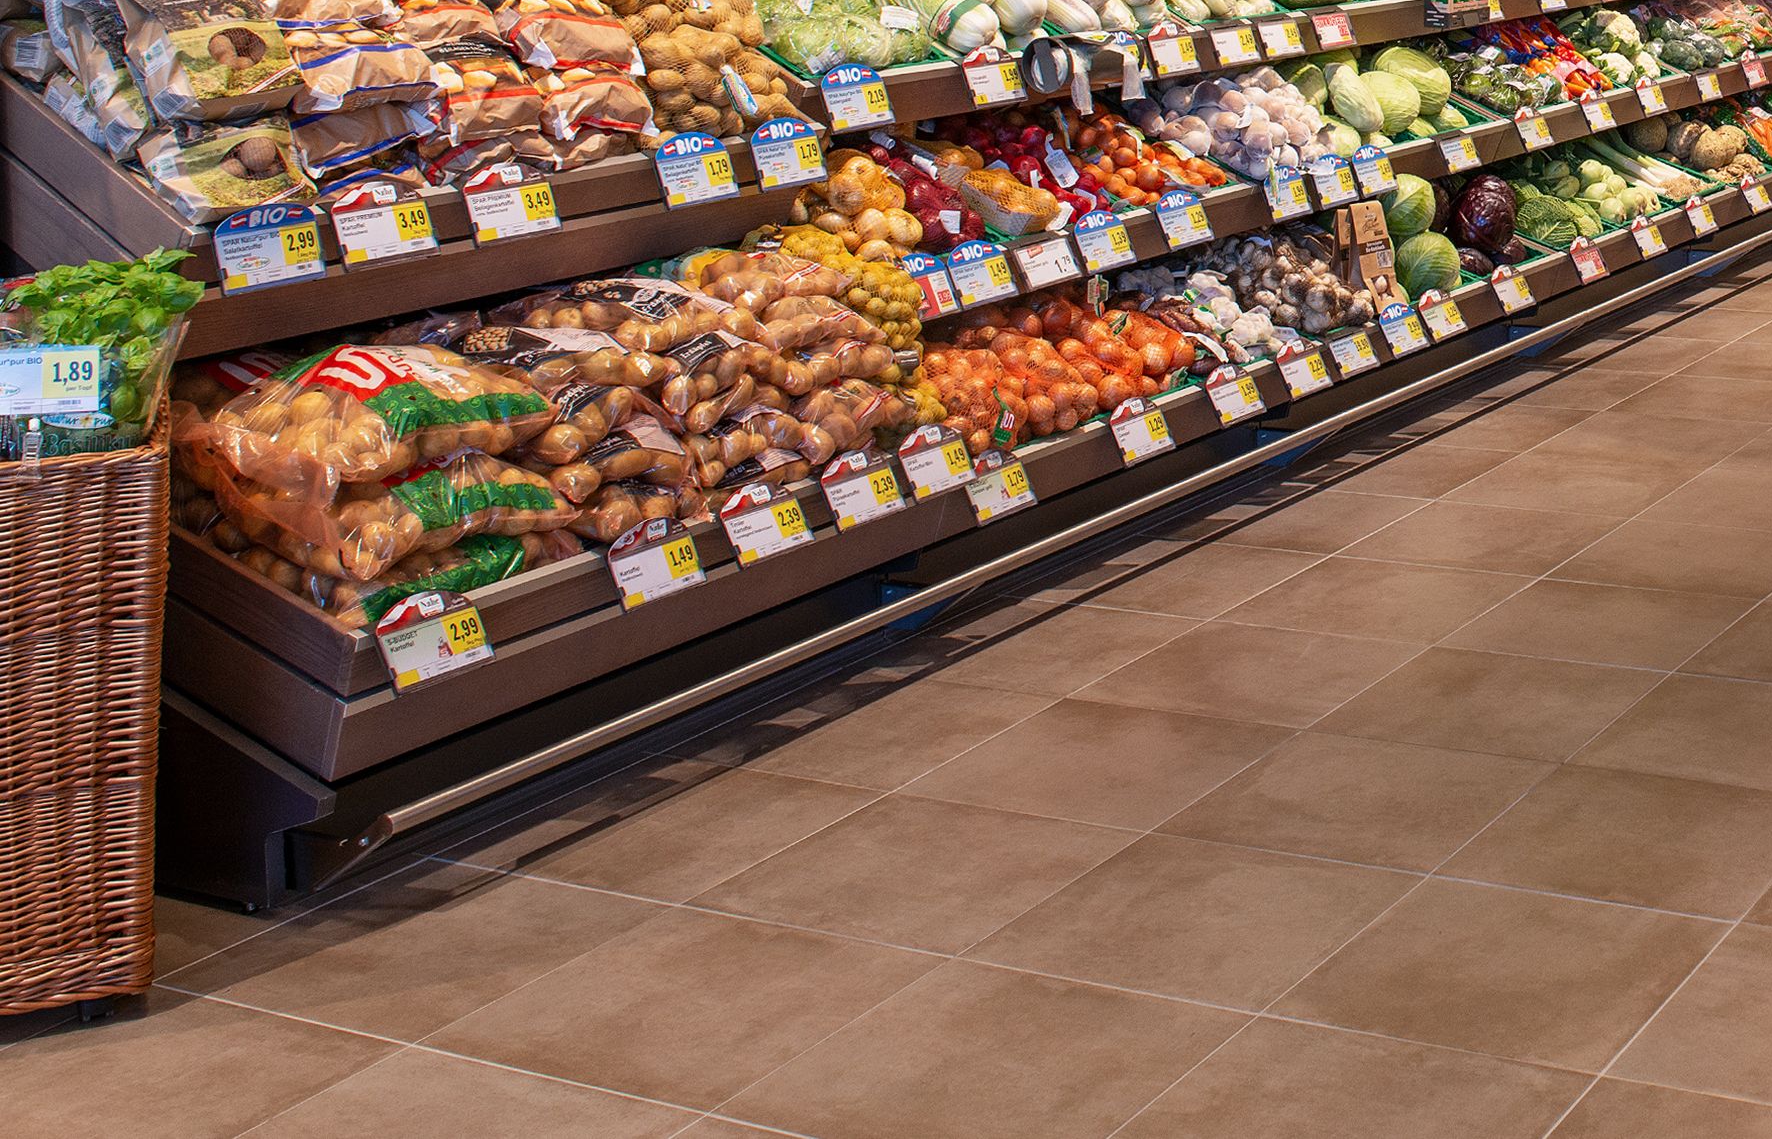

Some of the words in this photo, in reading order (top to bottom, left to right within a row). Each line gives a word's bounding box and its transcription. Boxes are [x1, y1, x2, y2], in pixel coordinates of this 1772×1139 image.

[837, 67, 861, 83] BIO
[868, 89, 885, 105] 2,19
[769, 122, 794, 139] BIO
[675, 137, 701, 155] BIO
[800, 143, 817, 160] 1,79
[1361, 149, 1374, 159] BIO
[709, 159, 728, 176] 1,79
[526, 190, 550, 211] 3,49
[1167, 194, 1184, 208] BIO
[249, 207, 286, 228] BIO
[398, 210, 425, 229] 3,49
[1087, 214, 1105, 227] BIO
[287, 230, 315, 252] 2,99
[961, 244, 983, 260] BIO
[989, 262, 1007, 278] 1,49
[1389, 308, 1402, 319] BIO
[27, 357, 42, 365] BIO
[53, 361, 92, 385] 1,89
[947, 449, 965, 465] 1,49
[874, 475, 894, 495] 2,39
[1007, 470, 1025, 486] 1,79
[778, 507, 801, 527] 2,39
[670, 544, 694, 567] 1,49
[450, 617, 478, 642] 2,99
[390, 641, 414, 653] Kartoffel
